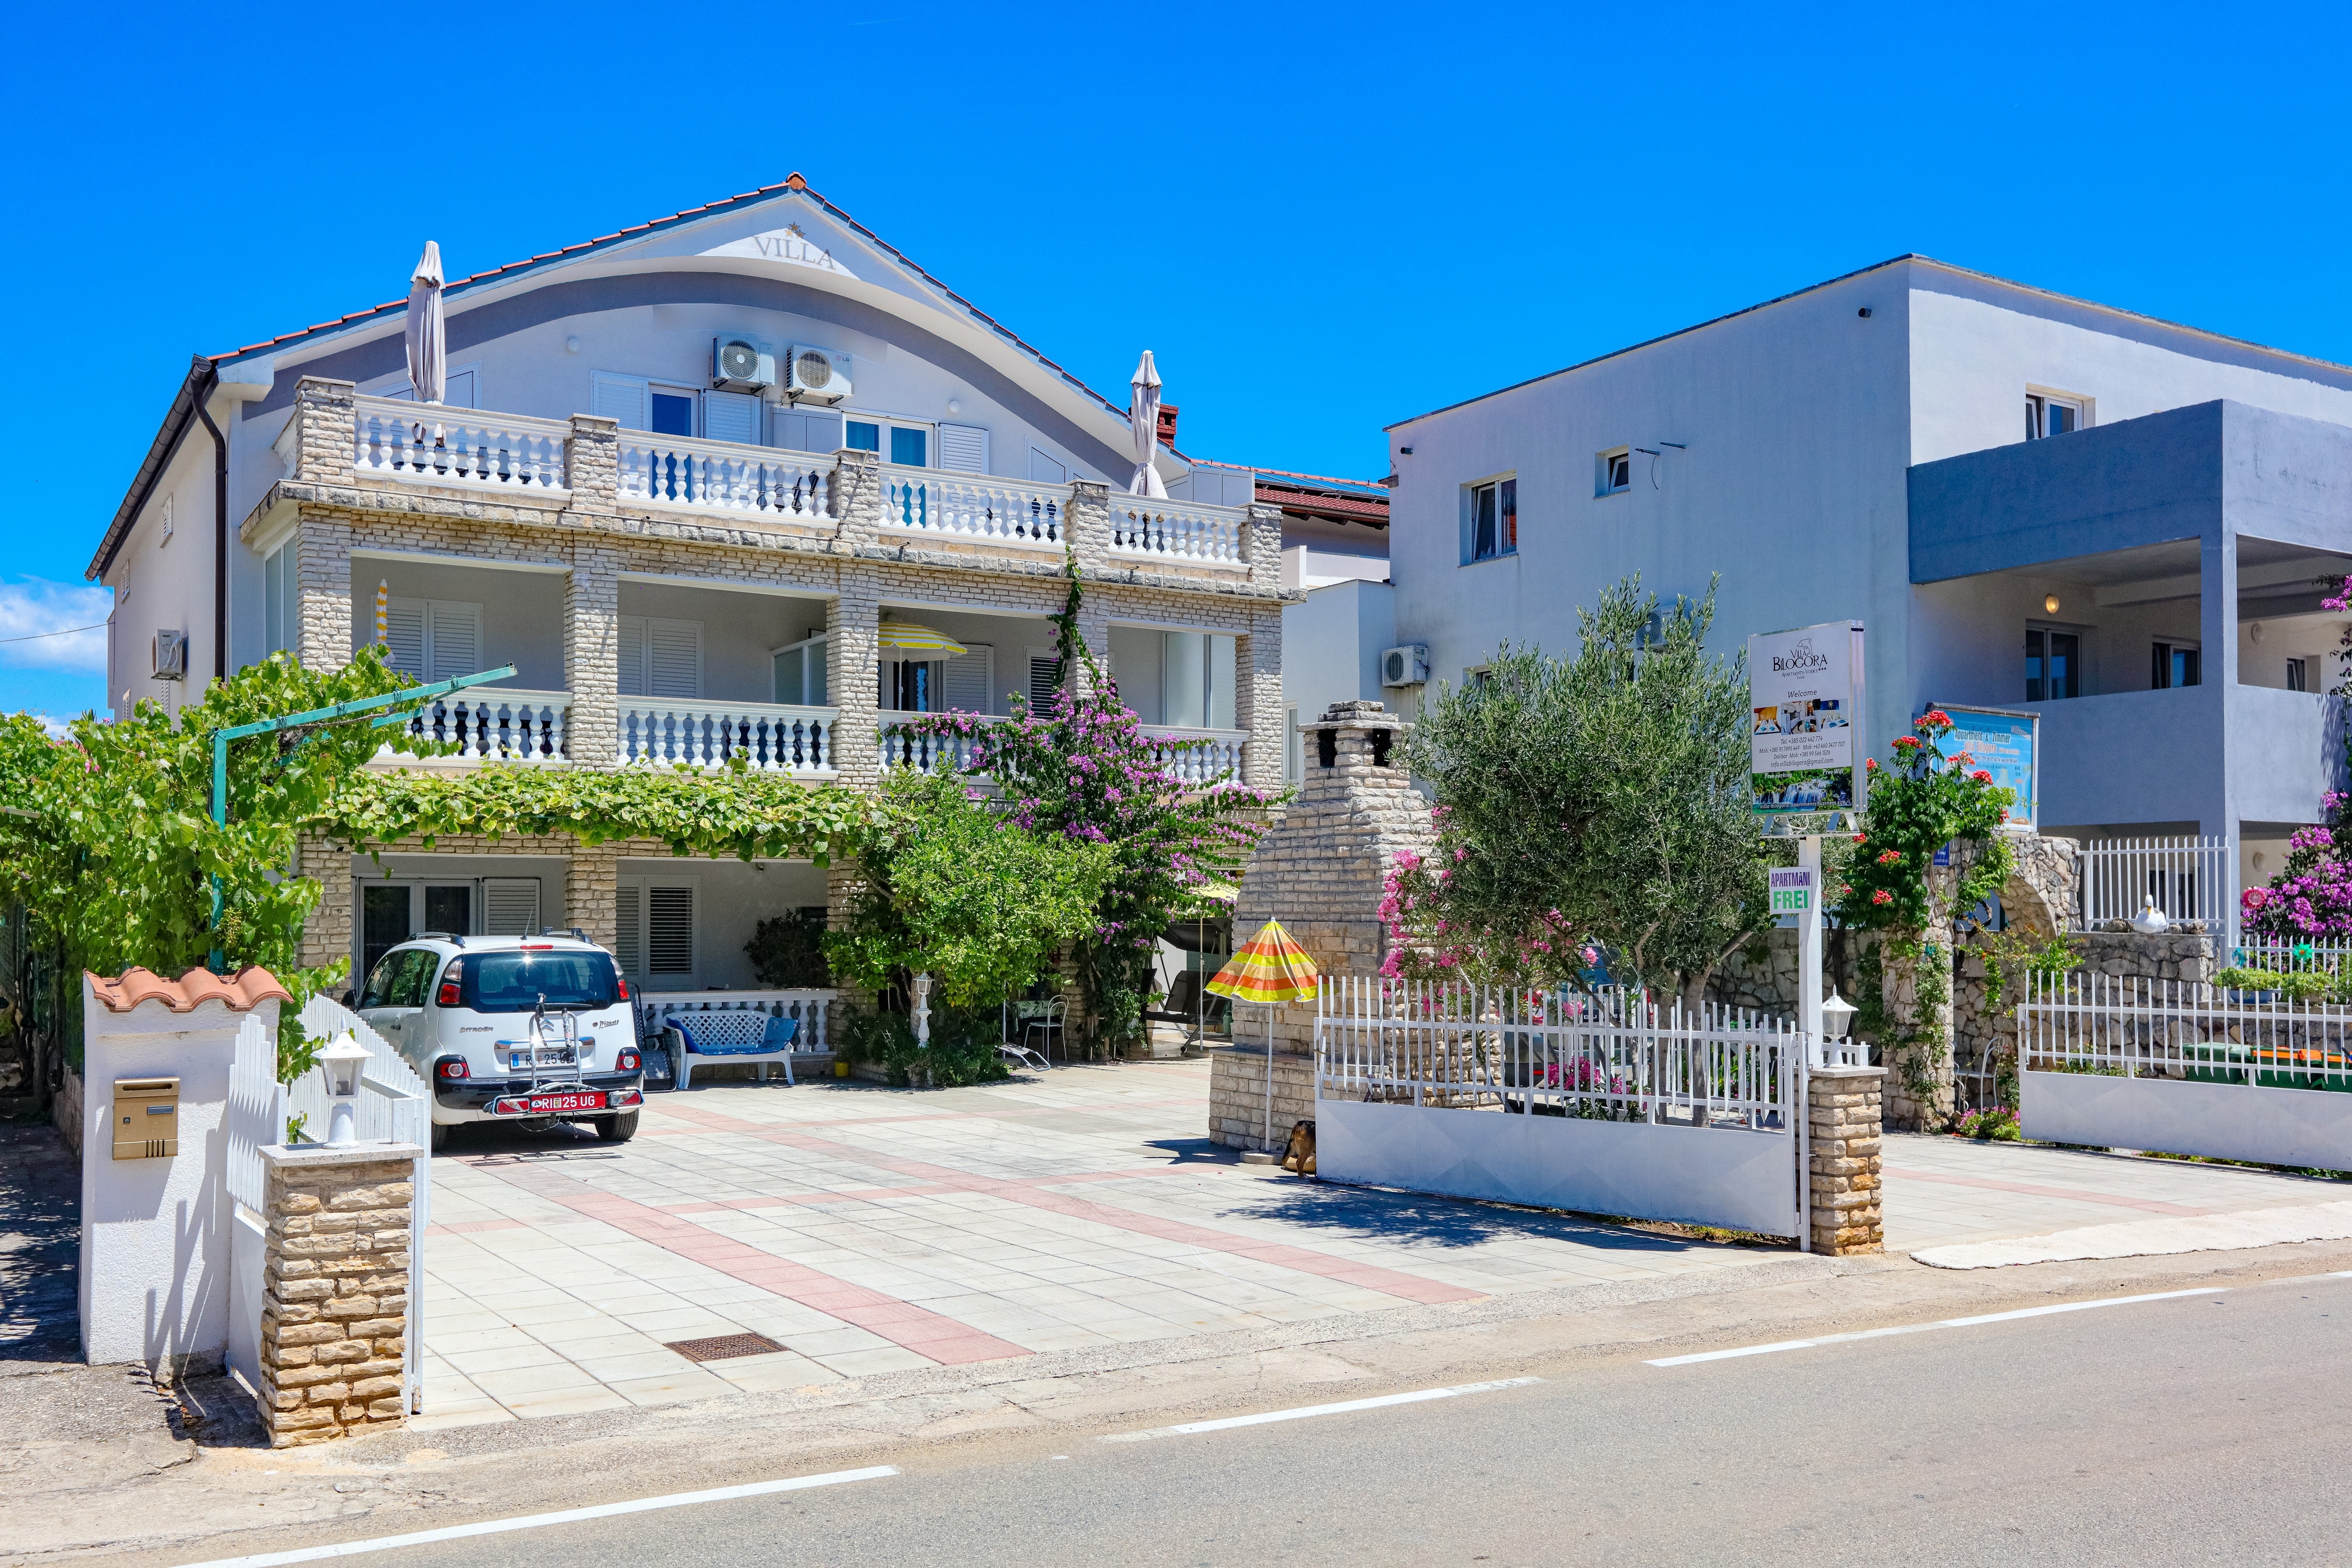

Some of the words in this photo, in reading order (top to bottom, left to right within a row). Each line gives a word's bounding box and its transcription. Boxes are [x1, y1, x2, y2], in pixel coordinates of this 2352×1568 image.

[752, 236, 837, 270] VILLA
[1773, 654, 1828, 671] BILOGORA
[1788, 690, 1818, 698] Welcome
[1955, 730, 1983, 741] Appartment
[1985, 733, 1989, 742] &
[1992, 731, 2010, 744] Zimmer
[1977, 741, 1996, 754] Bilogora
[1770, 758, 1834, 768] info.villabilogora@gmail.com
[1770, 871, 1810, 887] APARTMANI
[1773, 890, 1808, 909] FREI
[544, 1054, 557, 1064] 25
[542, 1098, 553, 1109] RI
[563, 1096, 577, 1108] 25
[580, 1095, 595, 1107] UG
